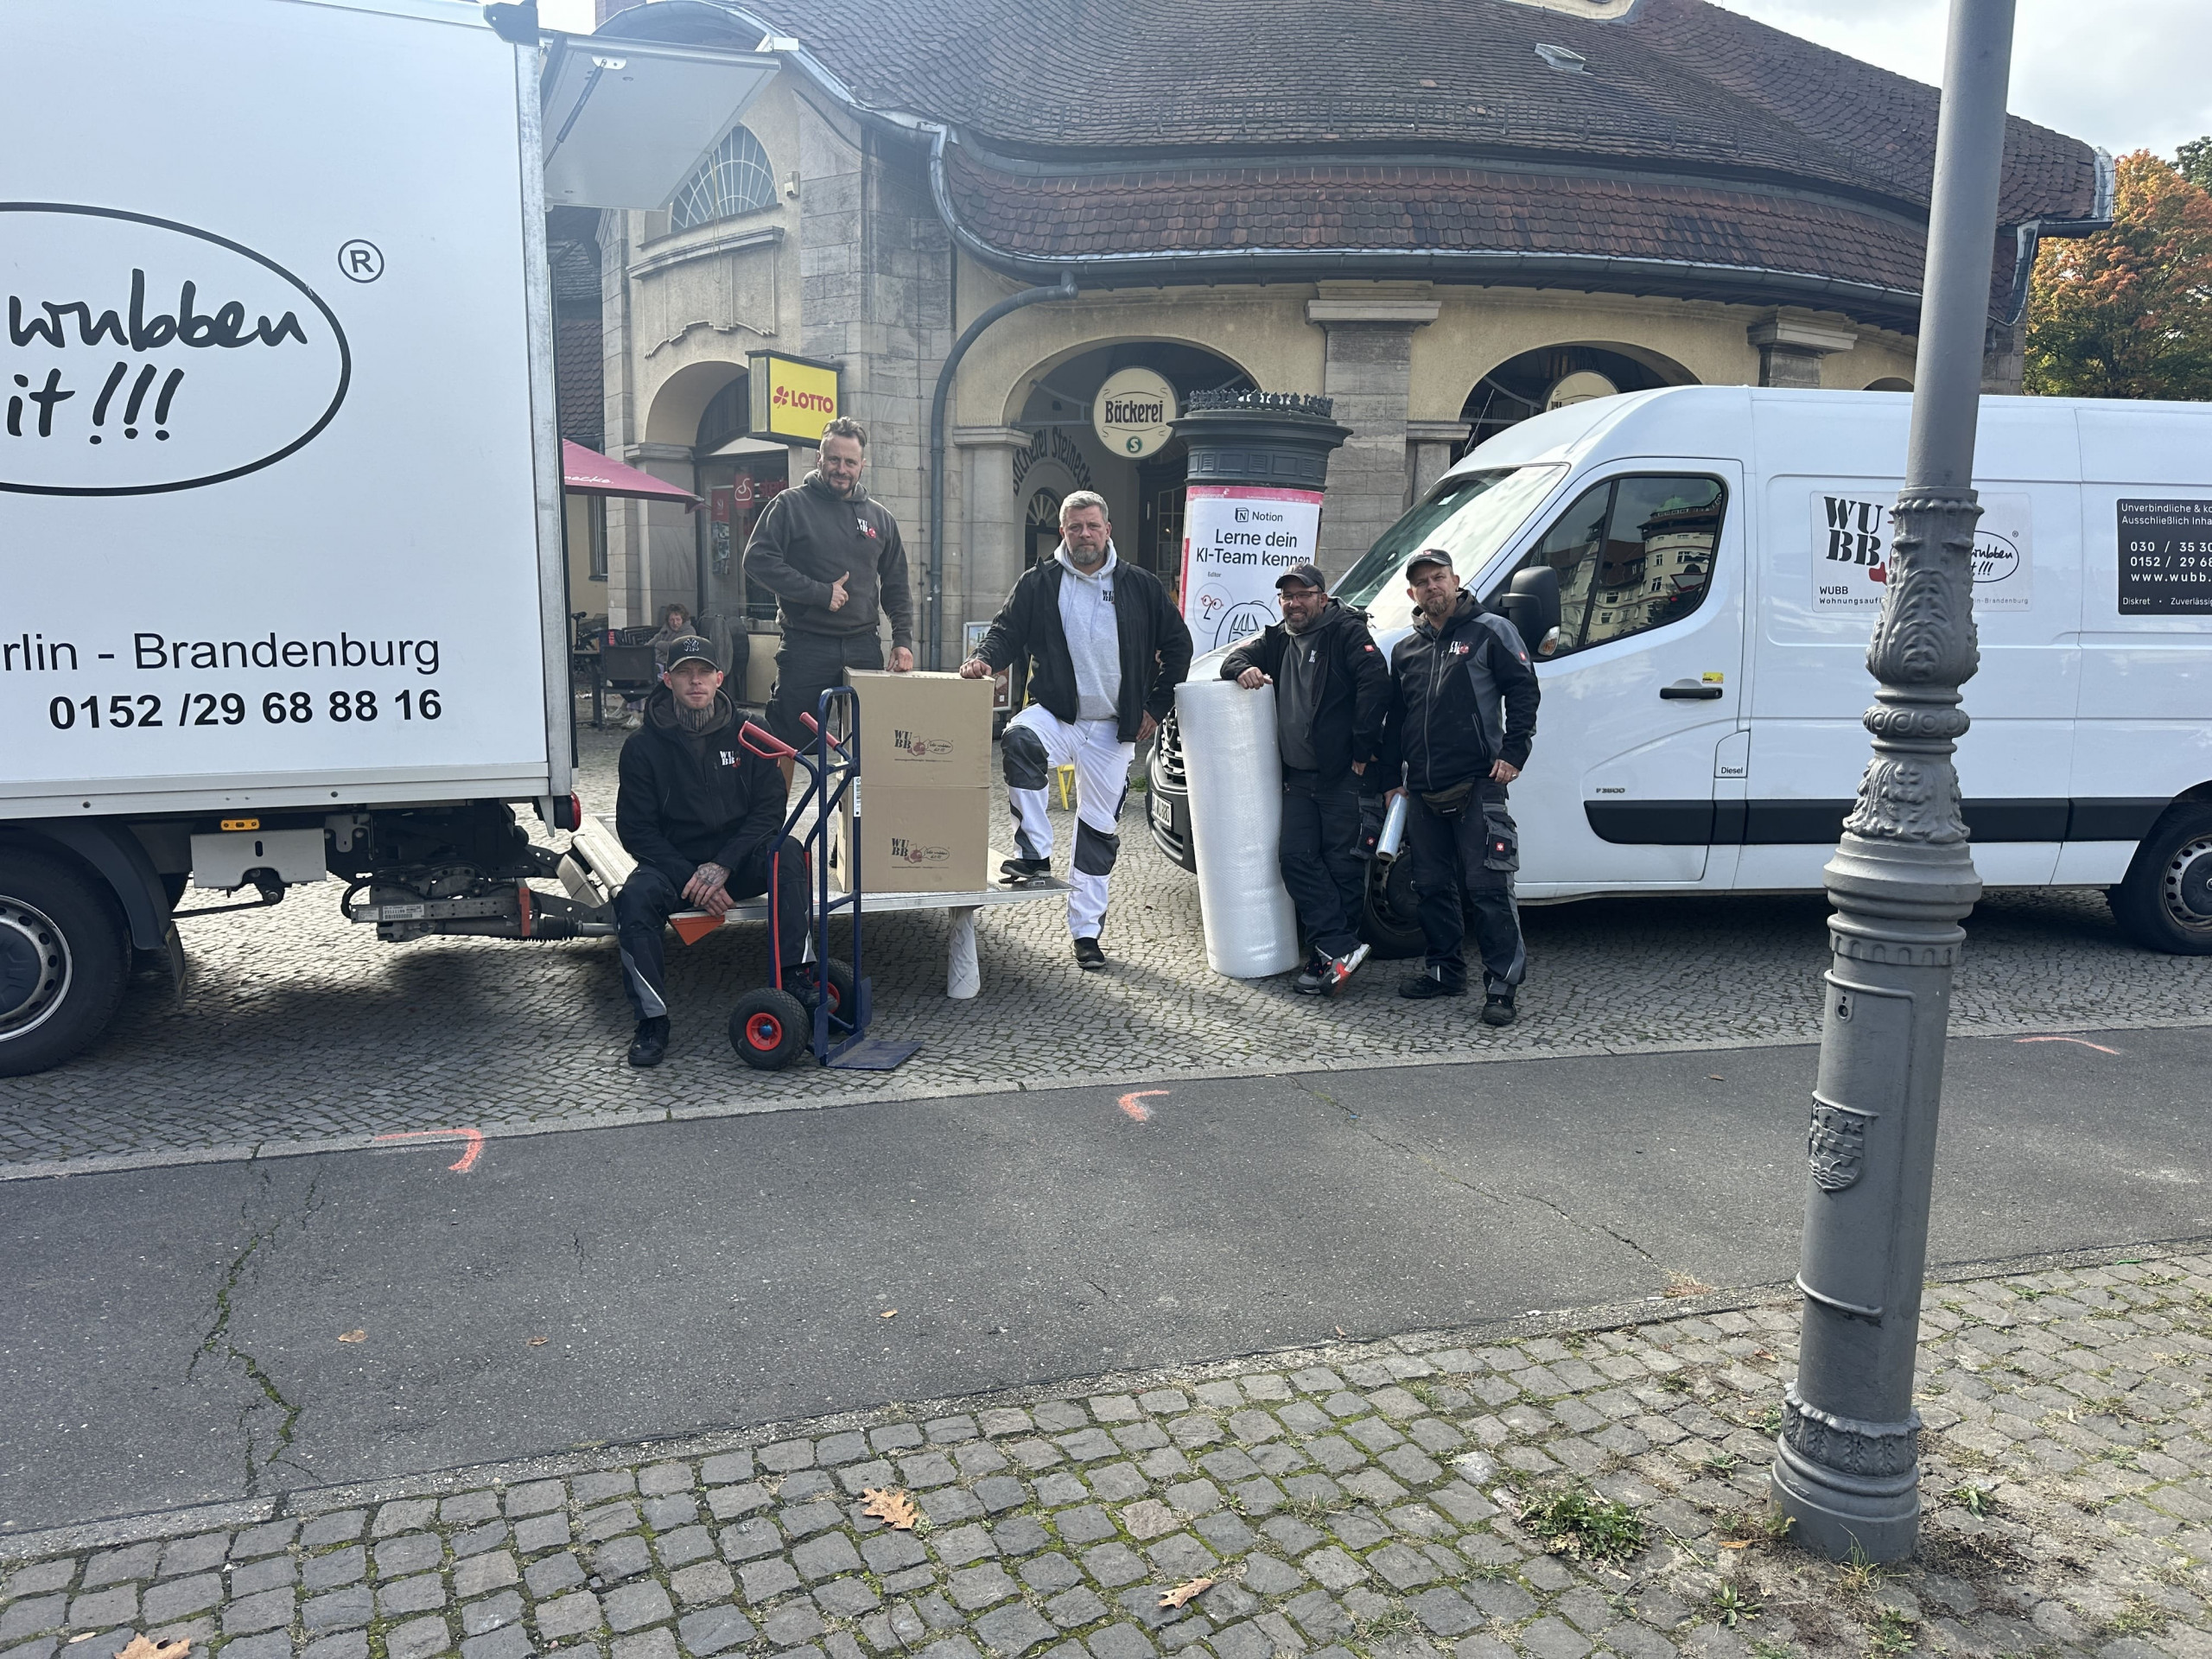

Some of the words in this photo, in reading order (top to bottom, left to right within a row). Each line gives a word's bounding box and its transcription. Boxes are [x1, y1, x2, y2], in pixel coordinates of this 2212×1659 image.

[7, 367, 76, 437] it
[791, 391, 834, 413] LOTTO
[1104, 400, 1164, 423] Bäckerei
[1252, 511, 1283, 522] Notion
[1823, 496, 1884, 535] WU
[2121, 503, 2191, 512] Unverbindliche
[2194, 504, 2201, 513] &
[2121, 516, 2190, 525] Ausschließlich
[1215, 529, 1262, 545] Lerne
[1265, 531, 1297, 548] dein
[2130, 542, 2155, 552] 030
[2164, 541, 2171, 553] /
[2179, 542, 2195, 552] 35
[1196, 547, 1257, 565] KI-Team
[1826, 529, 1881, 567] BB
[2130, 556, 2161, 567] 0152
[2164, 556, 2171, 568] /
[2179, 557, 2196, 567] 29
[2130, 572, 2212, 582] www.wubb.
[1819, 586, 1849, 595] WUBB
[2122, 597, 2151, 606] Diskret
[3, 633, 79, 671] rlin
[133, 632, 441, 675] Brandenburg
[49, 694, 164, 729] 0152
[179, 692, 246, 728] /29
[261, 690, 313, 725] 68
[328, 690, 378, 723] 88
[394, 689, 442, 721] 16
